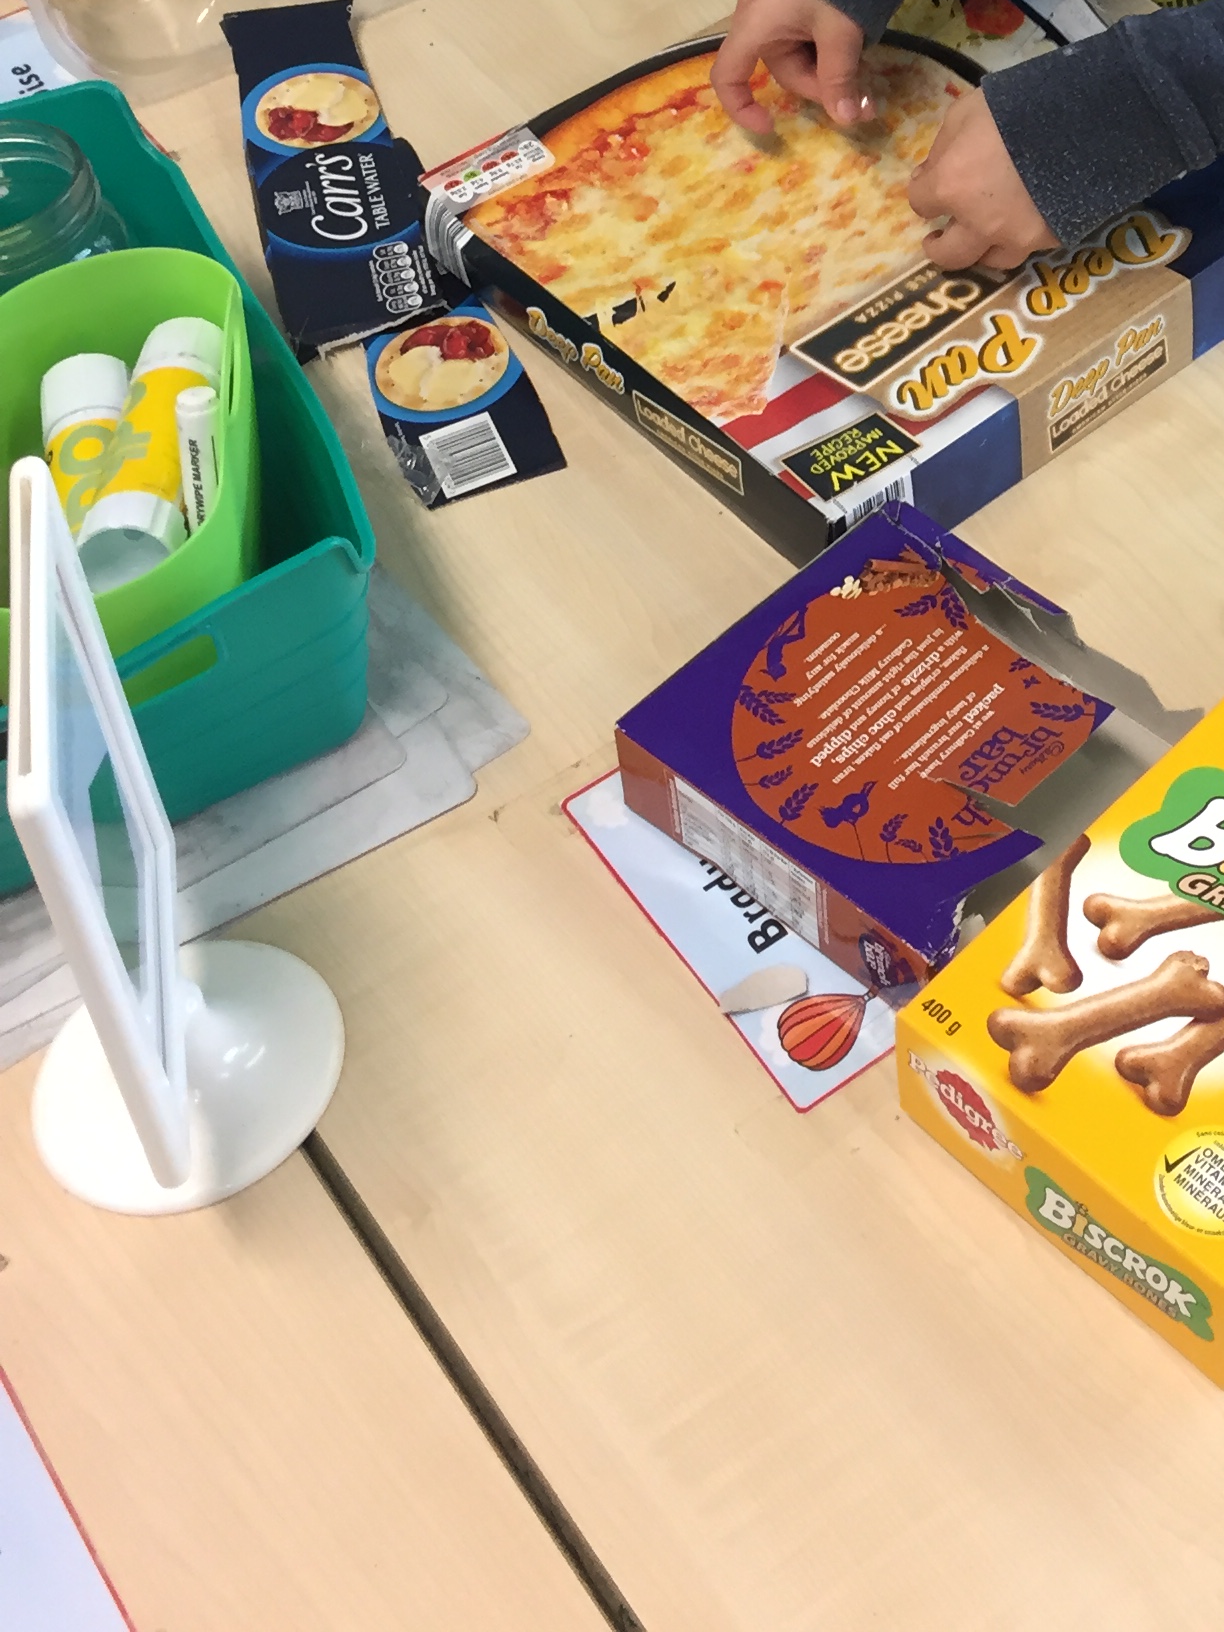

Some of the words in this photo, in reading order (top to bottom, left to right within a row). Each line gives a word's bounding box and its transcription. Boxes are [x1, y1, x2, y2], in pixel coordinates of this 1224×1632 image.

[11, 63, 49, 95] ise
[359, 152, 382, 195] WATER
[304, 153, 368, 240] Carr's
[368, 194, 391, 230] TABLE
[853, 289, 904, 324] PIZZA
[897, 313, 1041, 412] Pan
[1050, 358, 1110, 418] Deep
[1116, 316, 1164, 366] Pan
[1052, 385, 1109, 438] Loaded
[1110, 345, 1163, 392] Cheese
[638, 398, 686, 443] Loaded
[688, 429, 738, 479] Cheese
[809, 427, 885, 476] IMPROVED
[810, 423, 865, 459] RECIPE
[188, 438, 203, 482] MARKER
[830, 439, 905, 494] NEW
[835, 632, 860, 655] snack
[917, 634, 936, 653] just
[934, 627, 945, 638] in
[944, 629, 964, 648] with
[823, 652, 838, 667] for
[834, 634, 877, 673] deliciously
[878, 638, 913, 669] Cadbury
[900, 651, 940, 687] drizzle
[903, 650, 919, 664] the
[949, 650, 984, 682] delicious
[805, 664, 824, 681] any
[858, 667, 881, 686] Milk
[882, 661, 906, 683] right
[910, 667, 942, 696] crispies
[793, 670, 836, 707] satisfying
[851, 680, 884, 710] amount
[866, 692, 894, 716] honey
[891, 684, 902, 696] of
[893, 694, 913, 711] and
[902, 679, 951, 723] combination
[962, 682, 1006, 724] packed
[965, 690, 977, 703] of
[842, 707, 853, 720] of
[849, 714, 868, 731] and
[868, 709, 897, 736] choc
[946, 699, 968, 720] tasty
[972, 719, 983, 731] at
[981, 709, 995, 722] we
[806, 716, 844, 749] delicious
[893, 720, 904, 735] of
[947, 720, 964, 737] our
[809, 729, 852, 767] dipped
[831, 733, 869, 764] chips,
[918, 734, 951, 763] brunch
[939, 728, 976, 761] Cadbury
[958, 724, 1029, 782] bar
[832, 765, 856, 784] bran
[888, 773, 907, 791] full
[905, 759, 922, 777] bar
[917, 759, 943, 779] have
[699, 857, 788, 954] Brad
[921, 998, 952, 1025] 400
[945, 1019, 962, 1037] g
[908, 1049, 1024, 1161] Pedigree
[1062, 1232, 1119, 1274] GRAVY
[1122, 1271, 1180, 1319] BONES
